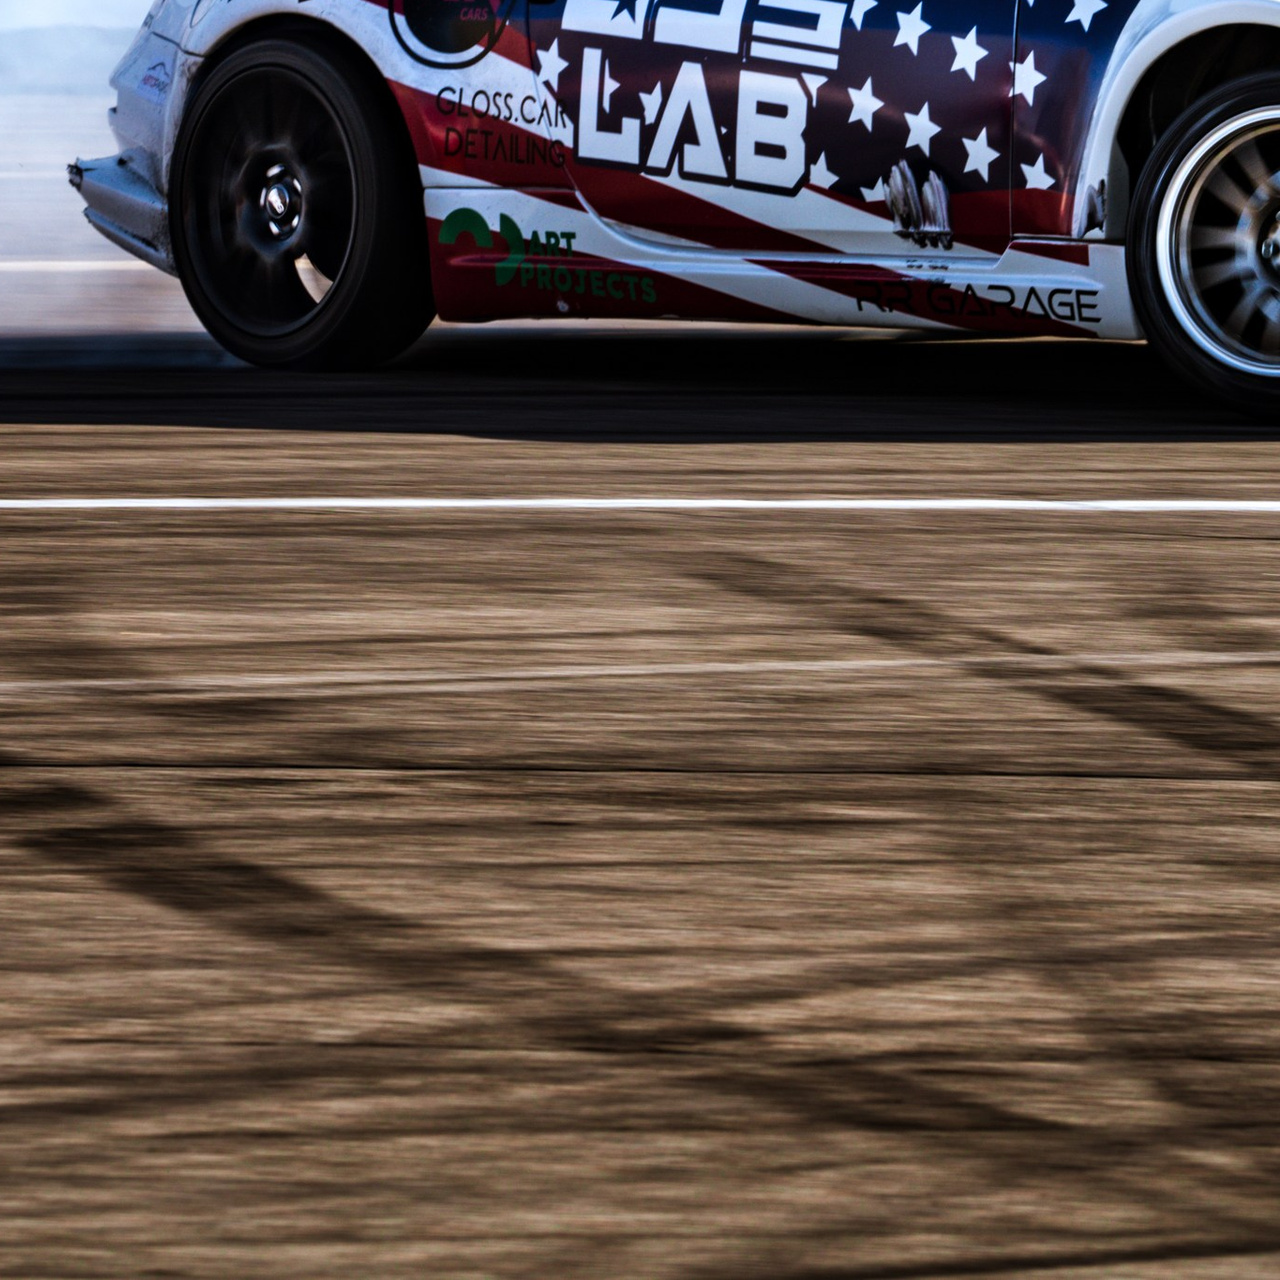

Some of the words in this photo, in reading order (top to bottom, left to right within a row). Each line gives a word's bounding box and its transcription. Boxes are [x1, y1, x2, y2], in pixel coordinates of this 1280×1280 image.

[460, 7, 489, 21] CARS
[578, 47, 808, 189] LAB
[444, 127, 565, 168] DETAILING
[529, 230, 576, 258] ART
[520, 262, 657, 304] PROJECTS
[926, 282, 1102, 324] GARAGE
